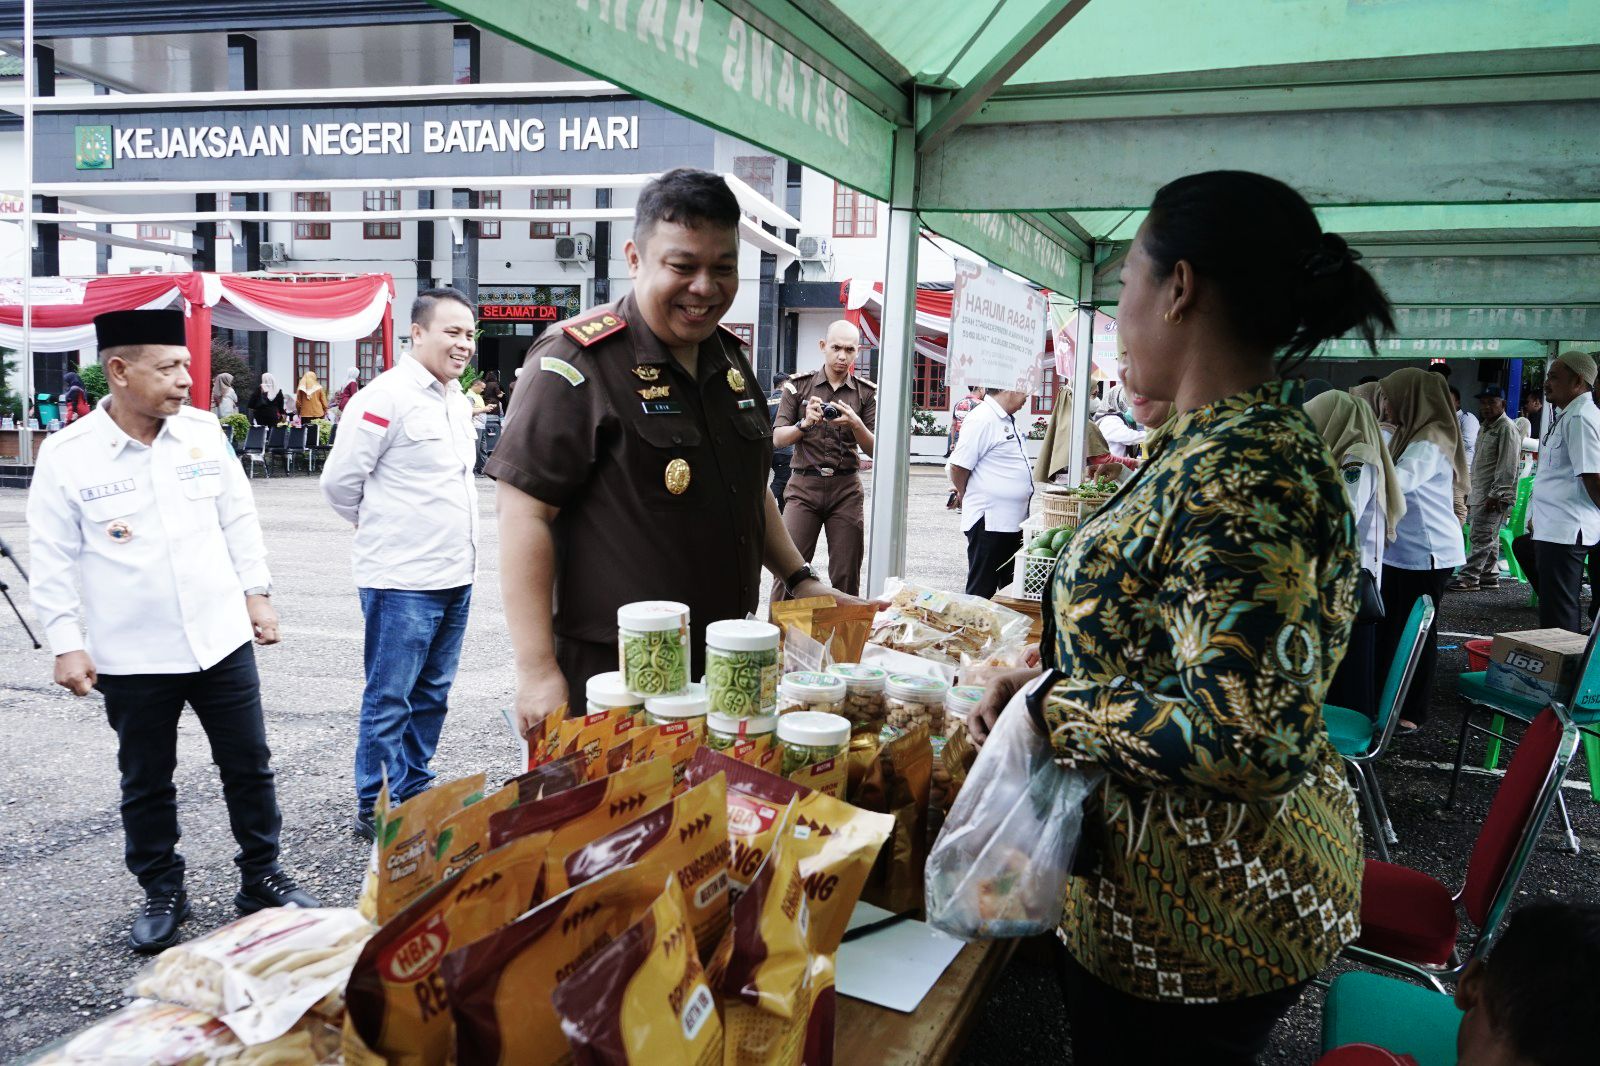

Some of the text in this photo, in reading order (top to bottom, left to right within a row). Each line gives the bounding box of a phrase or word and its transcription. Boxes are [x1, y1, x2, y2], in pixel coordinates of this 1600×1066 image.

[115, 115, 639, 159] KEJAKSAAN NEGERI BATANG HARI
[483, 306, 537, 317] SELAMAT
[87, 483, 129, 498] RIZAL
[1504, 651, 1545, 674] 168
[395, 932, 436, 974] HBA
